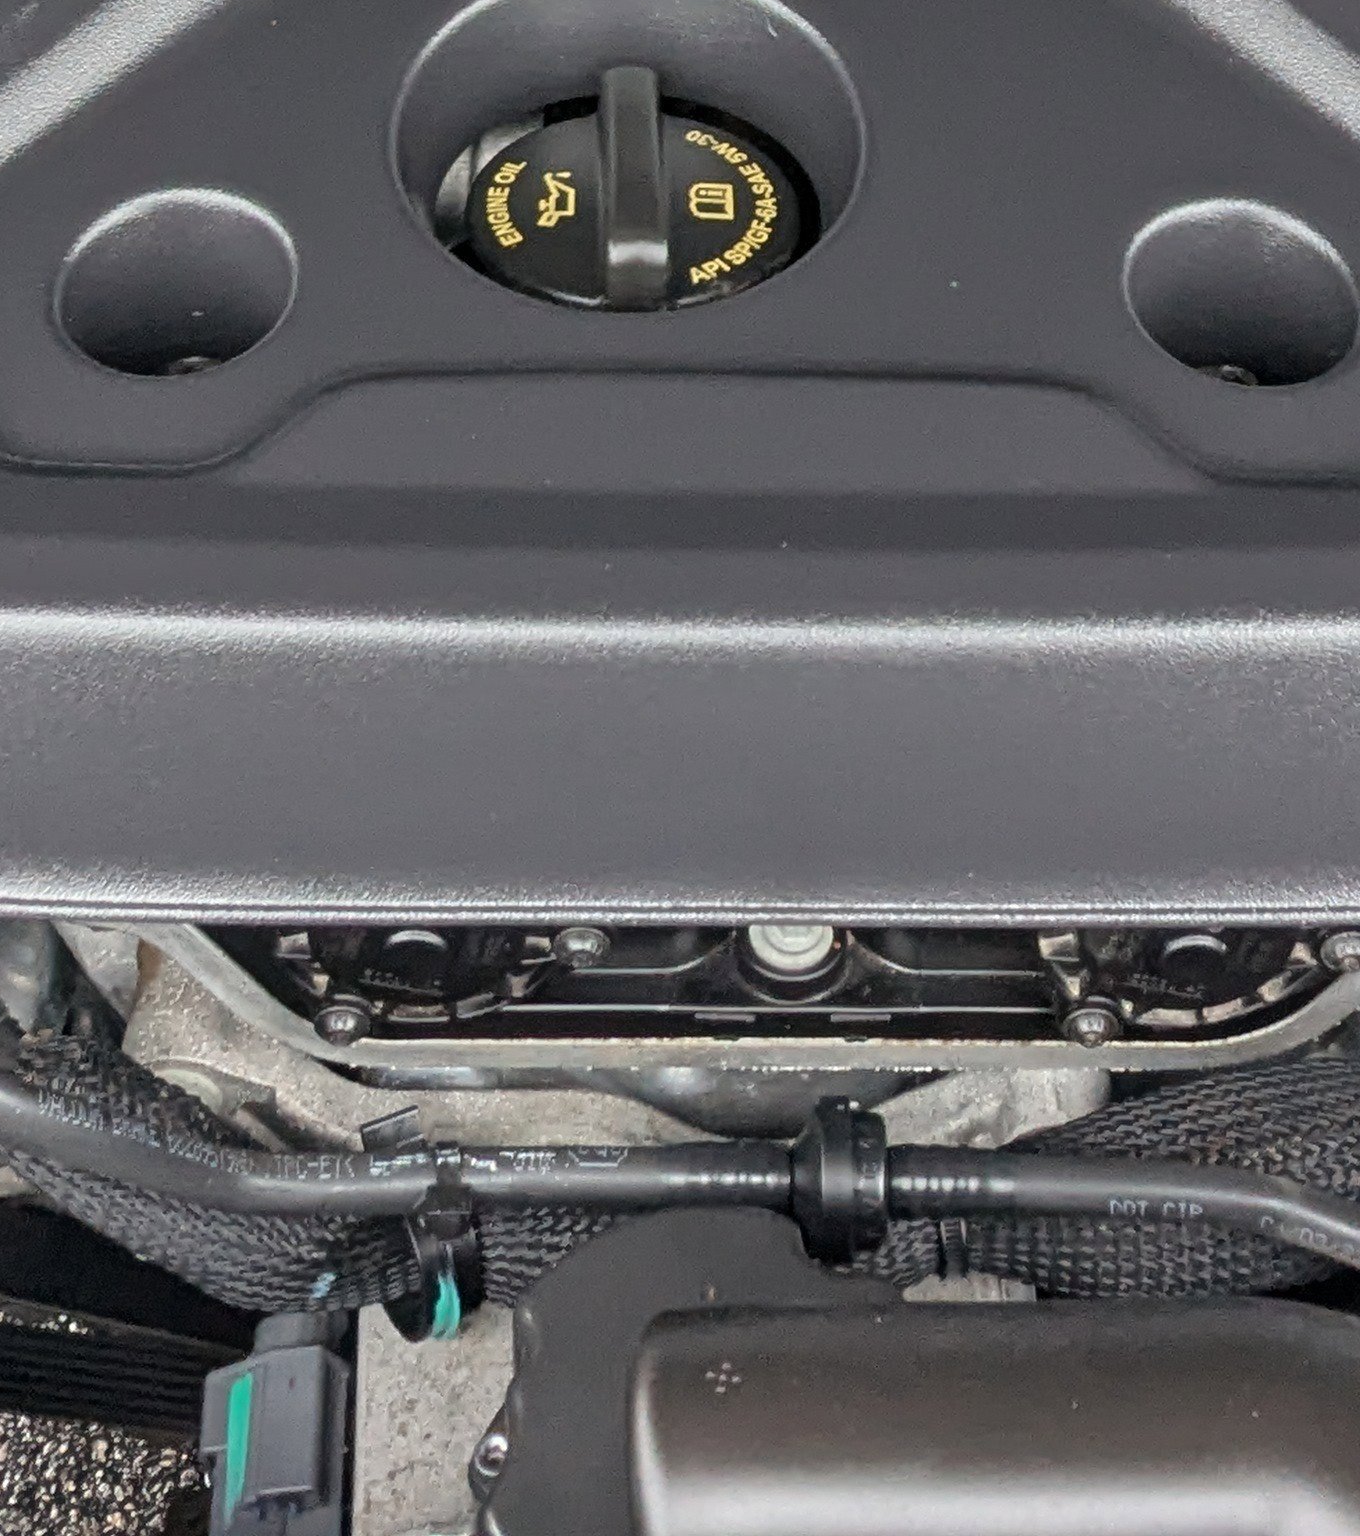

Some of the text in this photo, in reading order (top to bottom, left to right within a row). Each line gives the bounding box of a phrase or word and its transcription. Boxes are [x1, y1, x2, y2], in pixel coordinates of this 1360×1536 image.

[685, 129, 748, 164] 5W-30
[485, 161, 528, 247] ENGINE OIL
[690, 258, 731, 284] API
